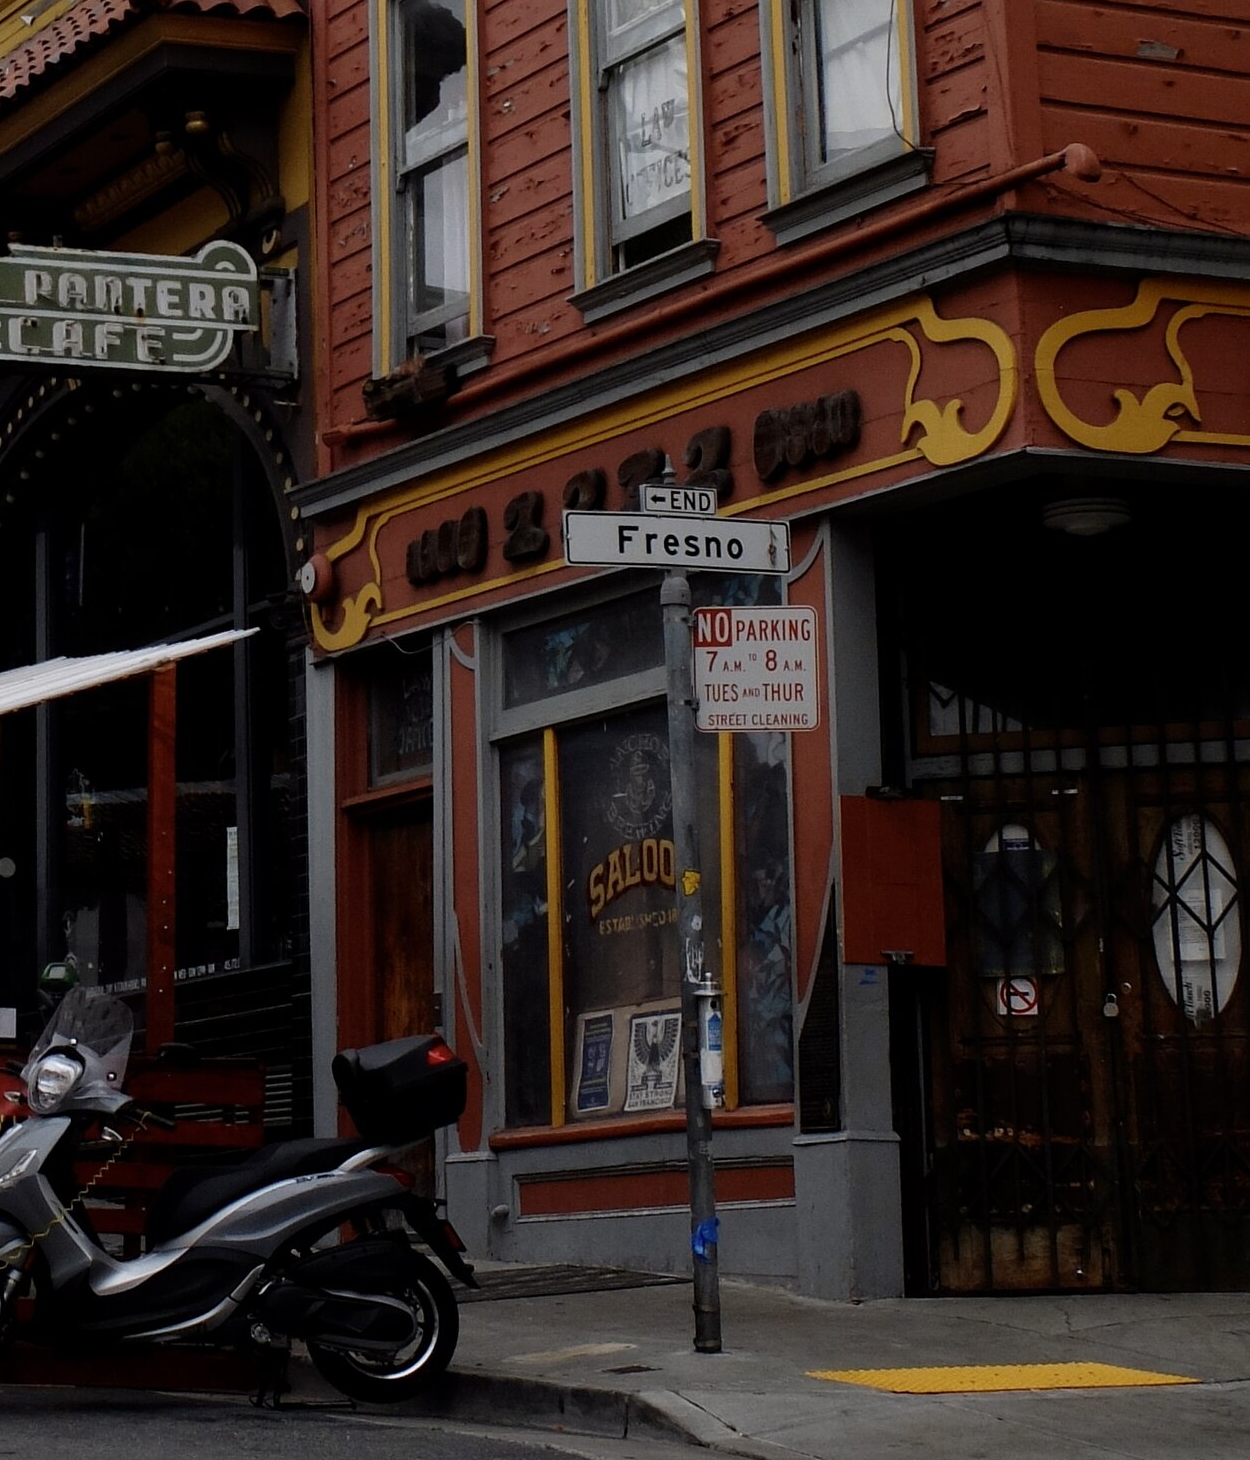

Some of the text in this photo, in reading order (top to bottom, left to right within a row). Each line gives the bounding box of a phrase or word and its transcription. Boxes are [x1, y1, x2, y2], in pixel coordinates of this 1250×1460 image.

[24, 270, 251, 324] PANTERA
[8, 317, 167, 365] CAFE
[670, 491, 711, 511] END
[617, 525, 744, 560] Fresno
[697, 612, 811, 643] NO PARKING
[705, 650, 807, 672] 7 A.M. TO 8 A.M.
[704, 683, 805, 702] TUES AND THUR
[708, 713, 809, 726] STREET CLEANING
[588, 838, 676, 920] SALOO
